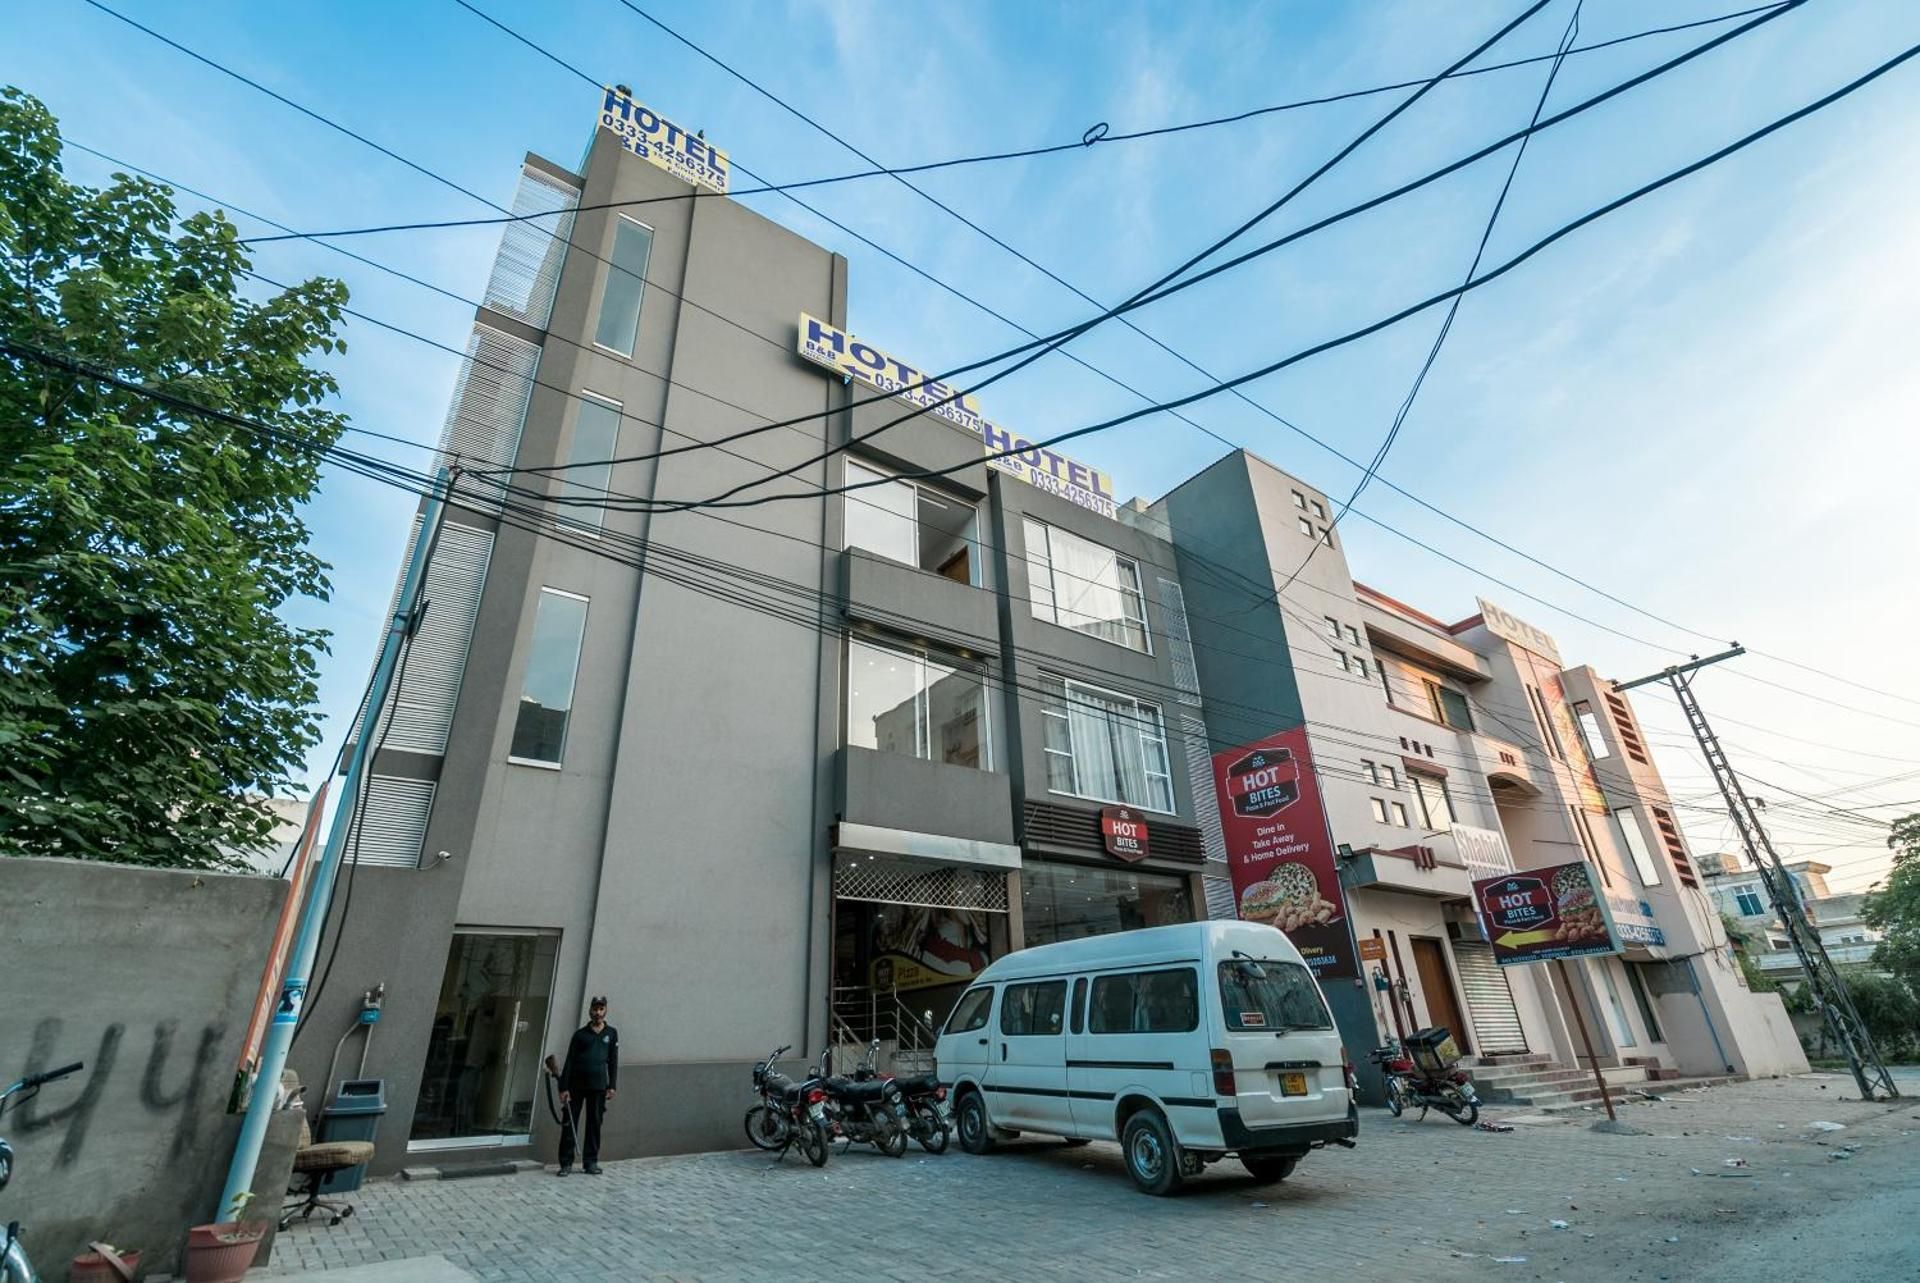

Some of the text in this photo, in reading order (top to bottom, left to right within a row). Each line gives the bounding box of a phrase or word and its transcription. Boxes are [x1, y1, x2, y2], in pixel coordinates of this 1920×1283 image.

[604, 88, 726, 176] HOTEL
[602, 114, 725, 187] 0333-4256375
[808, 320, 979, 417] HOTEL
[984, 422, 1112, 500] HOTEL
[1030, 469, 1113, 516] 0333-4256375
[1481, 600, 1559, 653] HOTEL
[1242, 766, 1279, 791] HOT
[1249, 786, 1281, 804] BITES
[1112, 821, 1137, 837] HOT
[1256, 826, 1276, 837] Dine
[1117, 837, 1138, 848] BITES
[1252, 833, 1295, 850] Take Away
[1251, 850, 1275, 862] Home
[1275, 843, 1310, 857] Delivery
[1498, 891, 1532, 910] HOT
[1506, 906, 1536, 919] BITES
